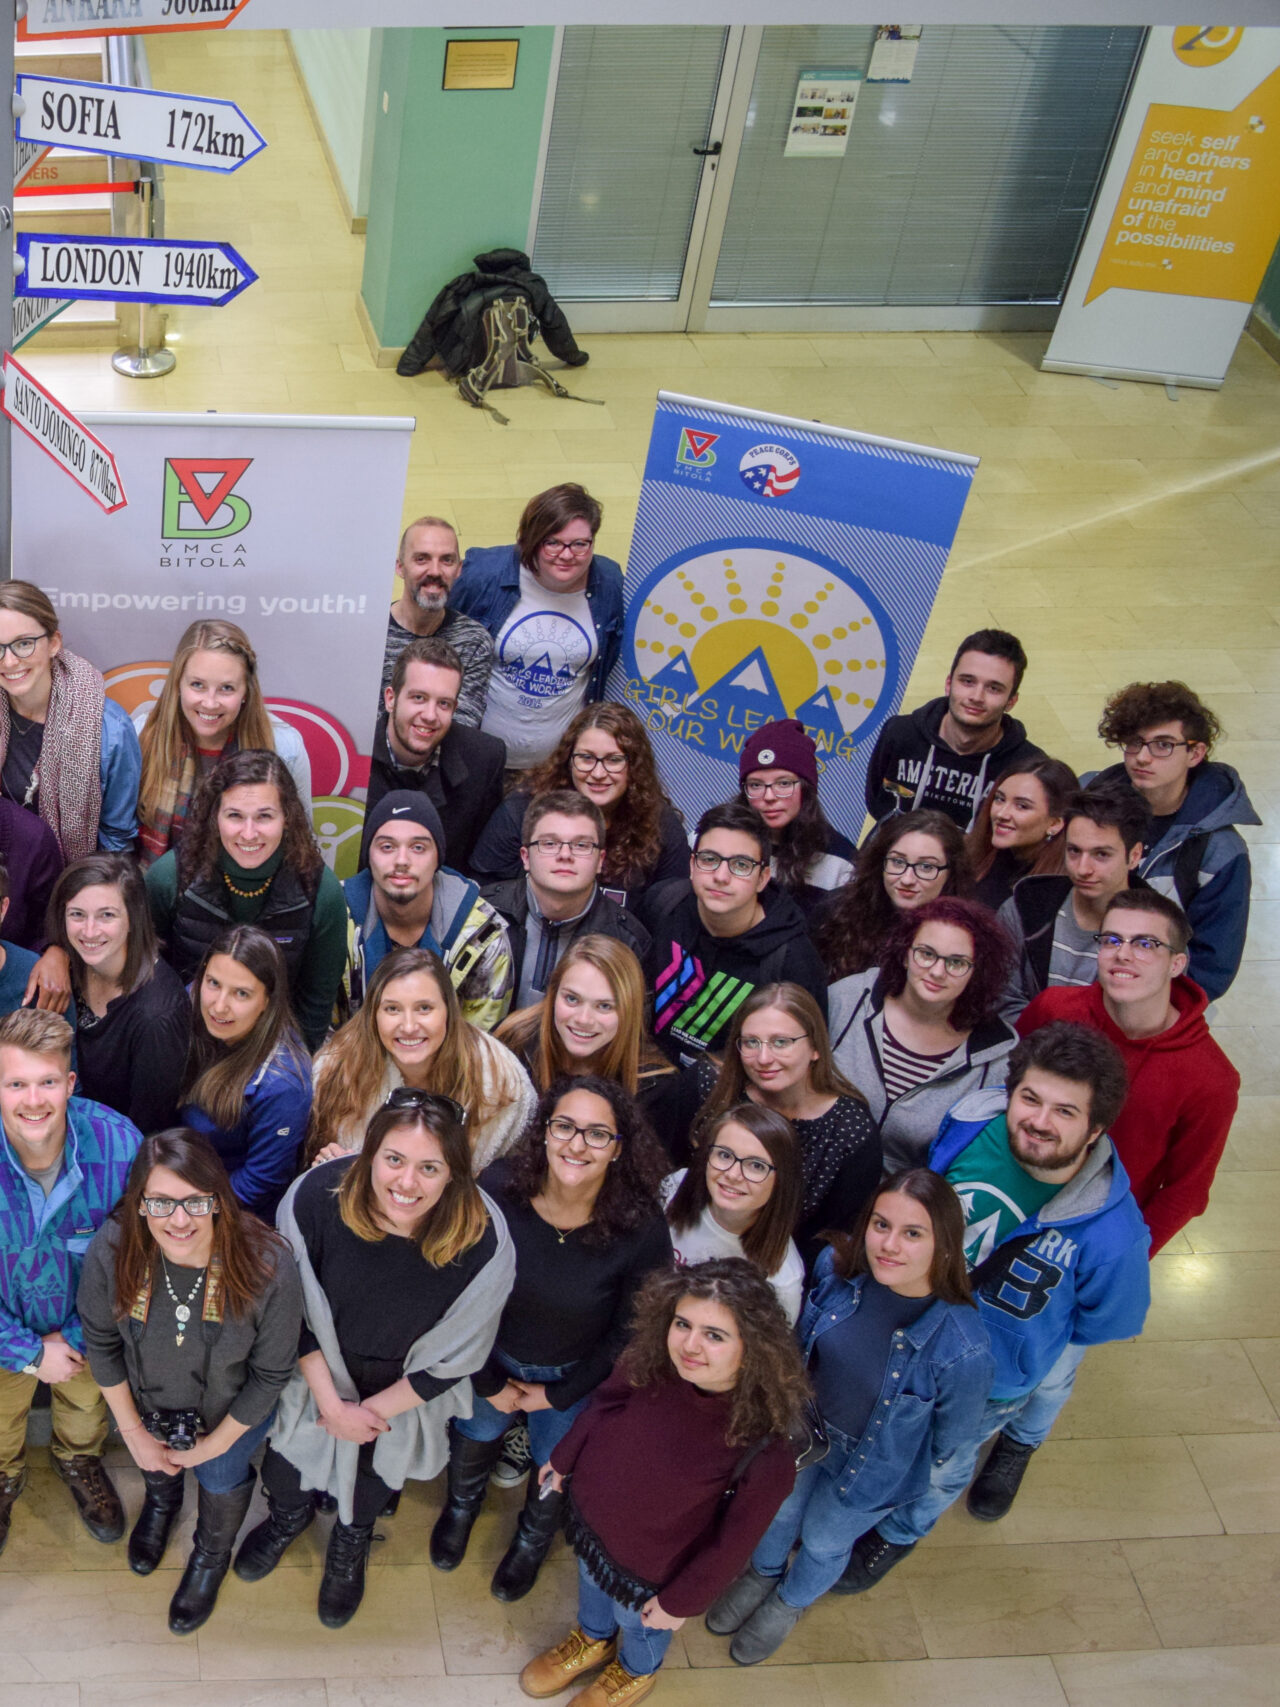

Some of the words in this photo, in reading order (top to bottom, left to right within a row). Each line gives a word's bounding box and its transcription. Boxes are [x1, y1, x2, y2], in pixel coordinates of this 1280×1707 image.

[40, 90, 122, 141] SOFIA
[166, 108, 246, 159] 172km
[1150, 130, 1196, 146] seek
[1200, 135, 1240, 151] self
[1144, 147, 1183, 163] and
[1186, 151, 1251, 171] others
[1138, 161, 1156, 177] in
[1159, 163, 1214, 184] heart
[1132, 180, 1171, 196] and
[1174, 185, 1228, 202] mind
[1127, 197, 1212, 218] unafraid
[1122, 212, 1145, 227] of
[1147, 214, 1178, 232] the
[1115, 229, 1236, 254] possibilities
[40, 245, 144, 287] LONDON
[163, 251, 239, 292] 1940km
[14, 376, 42, 430] SANTO
[42, 403, 87, 473] DOMINGO
[749, 446, 774, 459] PEACE
[775, 447, 797, 466] CORPS
[673, 469, 712, 483] BITOLA
[161, 543, 247, 554] YMCA
[160, 556, 246, 568] BITOLA
[44, 587, 247, 614] Empowering
[260, 594, 367, 617] youth!
[623, 678, 719, 721] GIRLS
[646, 709, 706, 746] OUR
[924, 790, 973, 808] BIKETOWN
